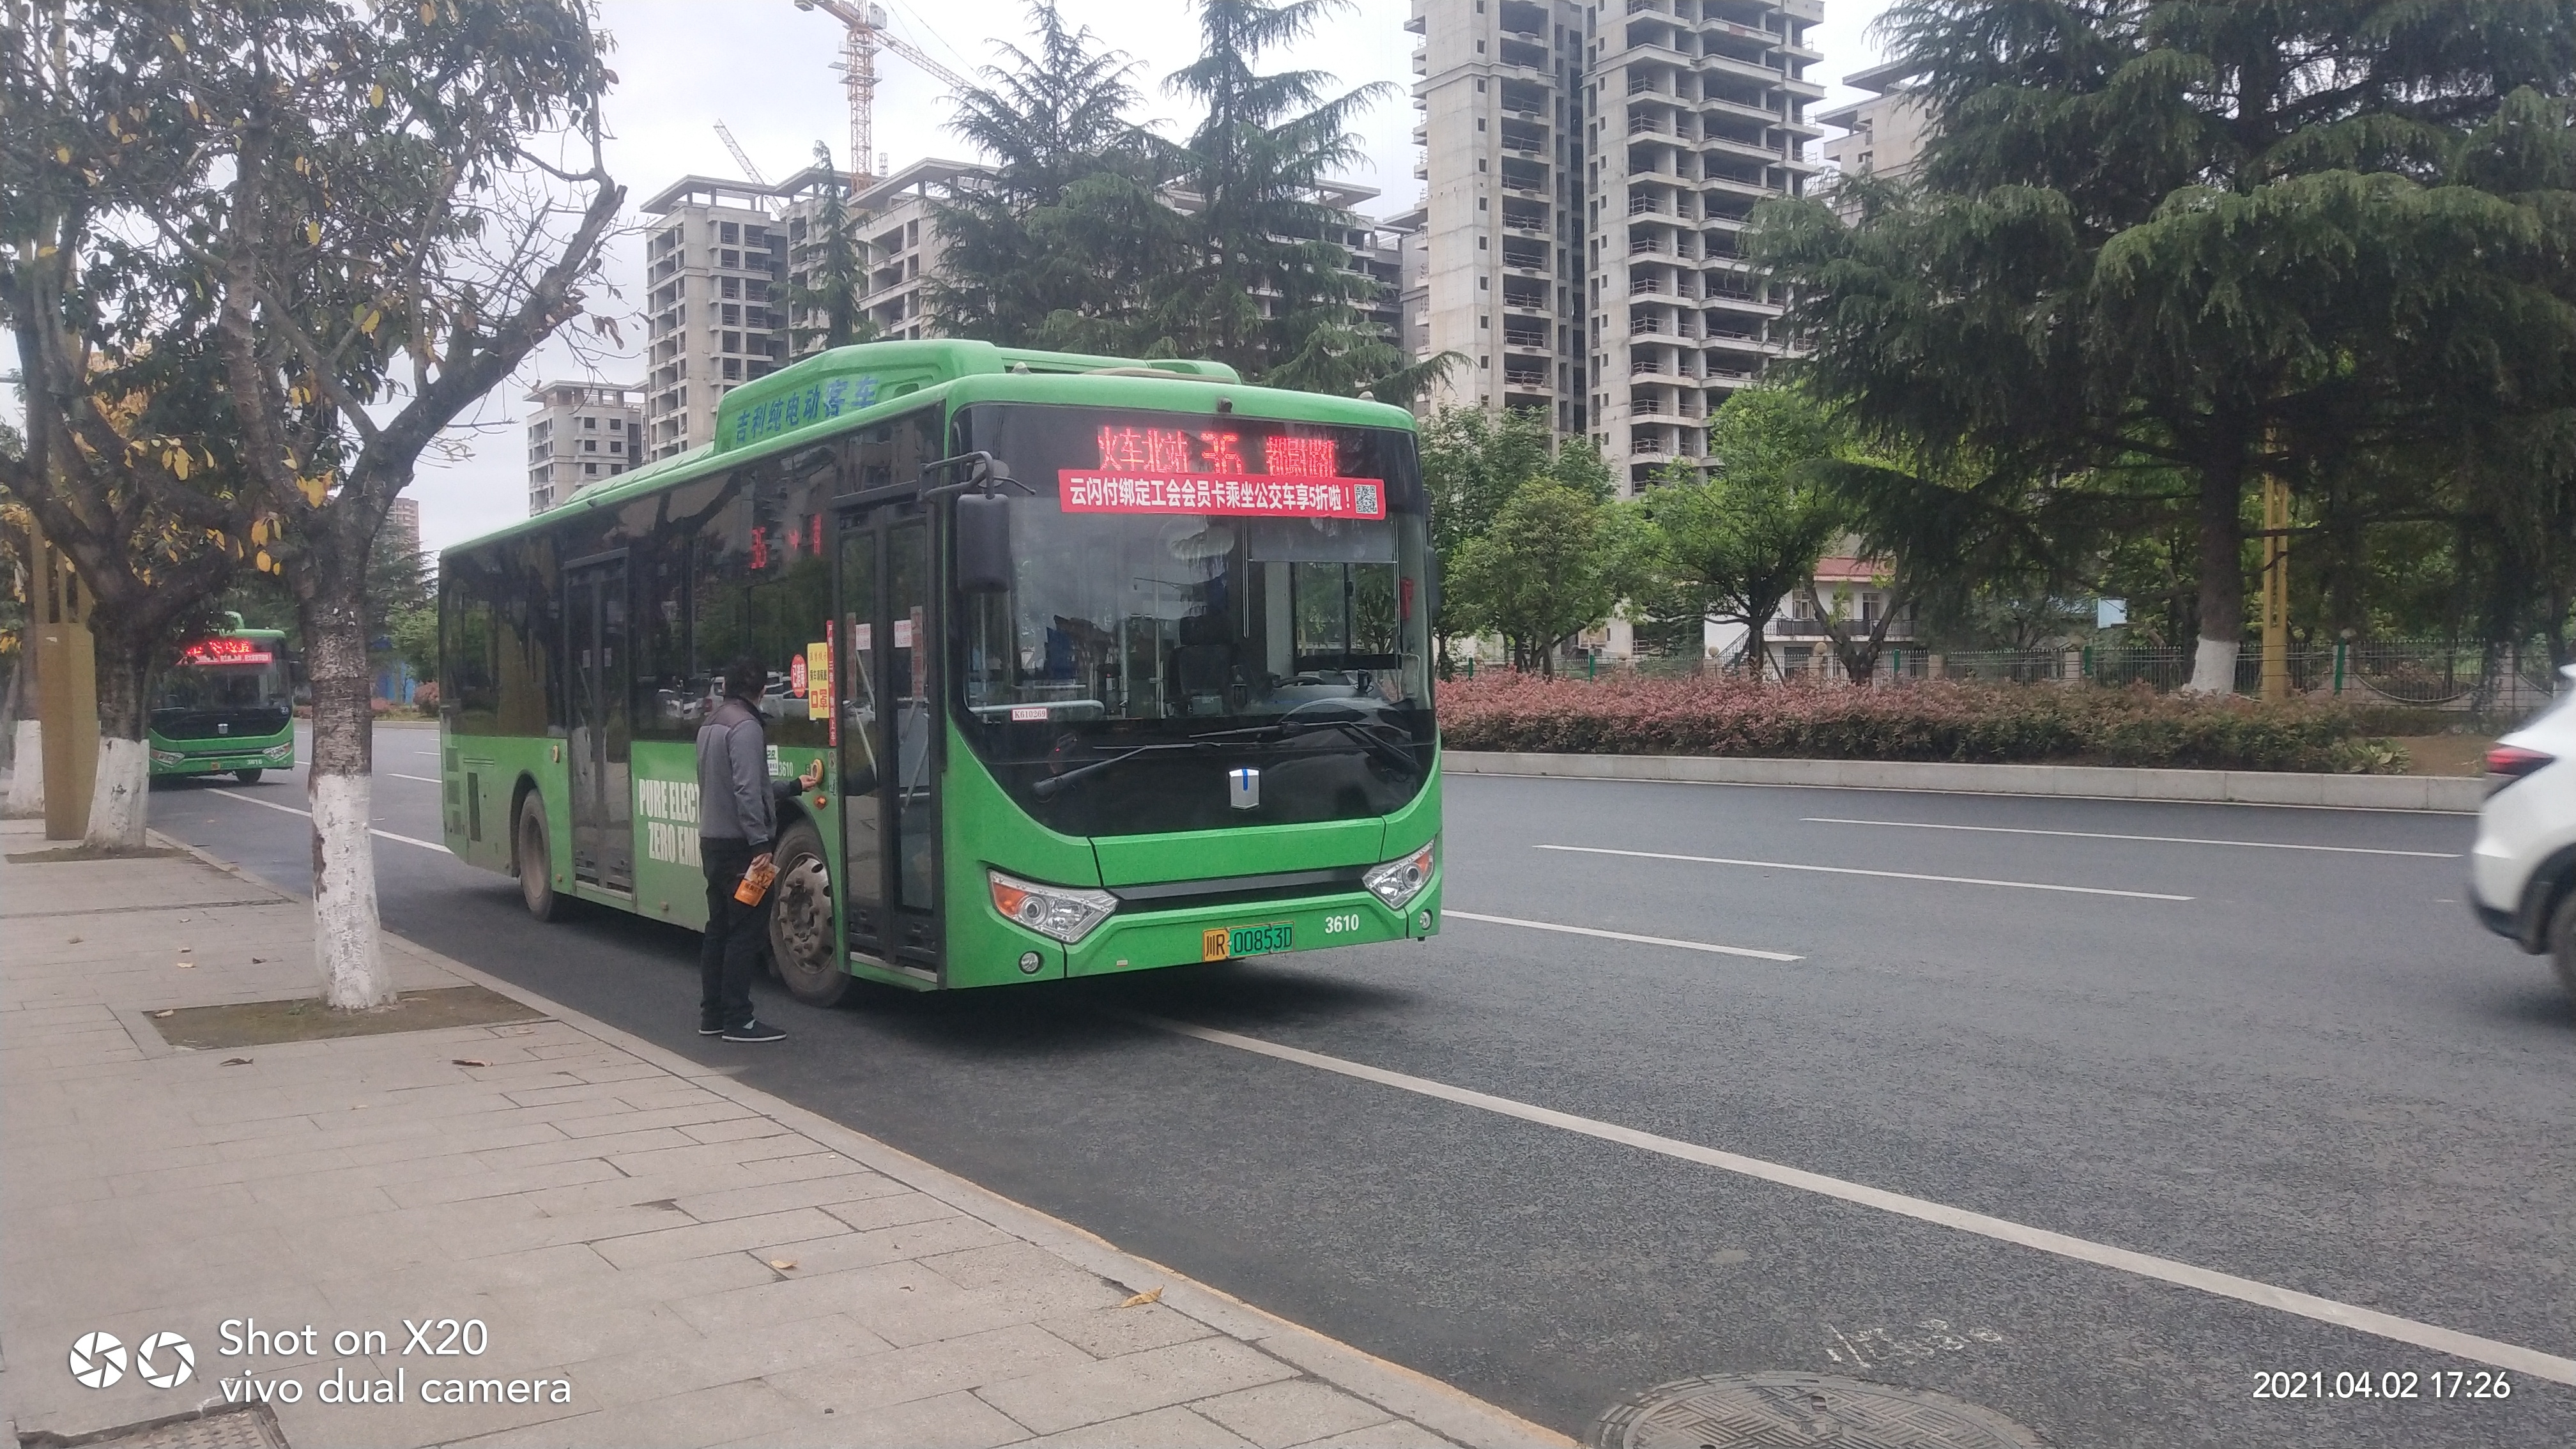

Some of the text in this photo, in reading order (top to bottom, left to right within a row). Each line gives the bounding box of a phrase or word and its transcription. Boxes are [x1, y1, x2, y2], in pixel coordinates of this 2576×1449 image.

[736, 376, 878, 443] 吉利纯电动客车
[1098, 426, 1188, 473] 火车北站
[811, 689, 828, 710] 口罩
[1014, 710, 1046, 719] K610269
[779, 761, 793, 777] 3610
[639, 778, 668, 819] PURE
[648, 821, 676, 864] ZERO
[1324, 914, 1359, 934] 3610
